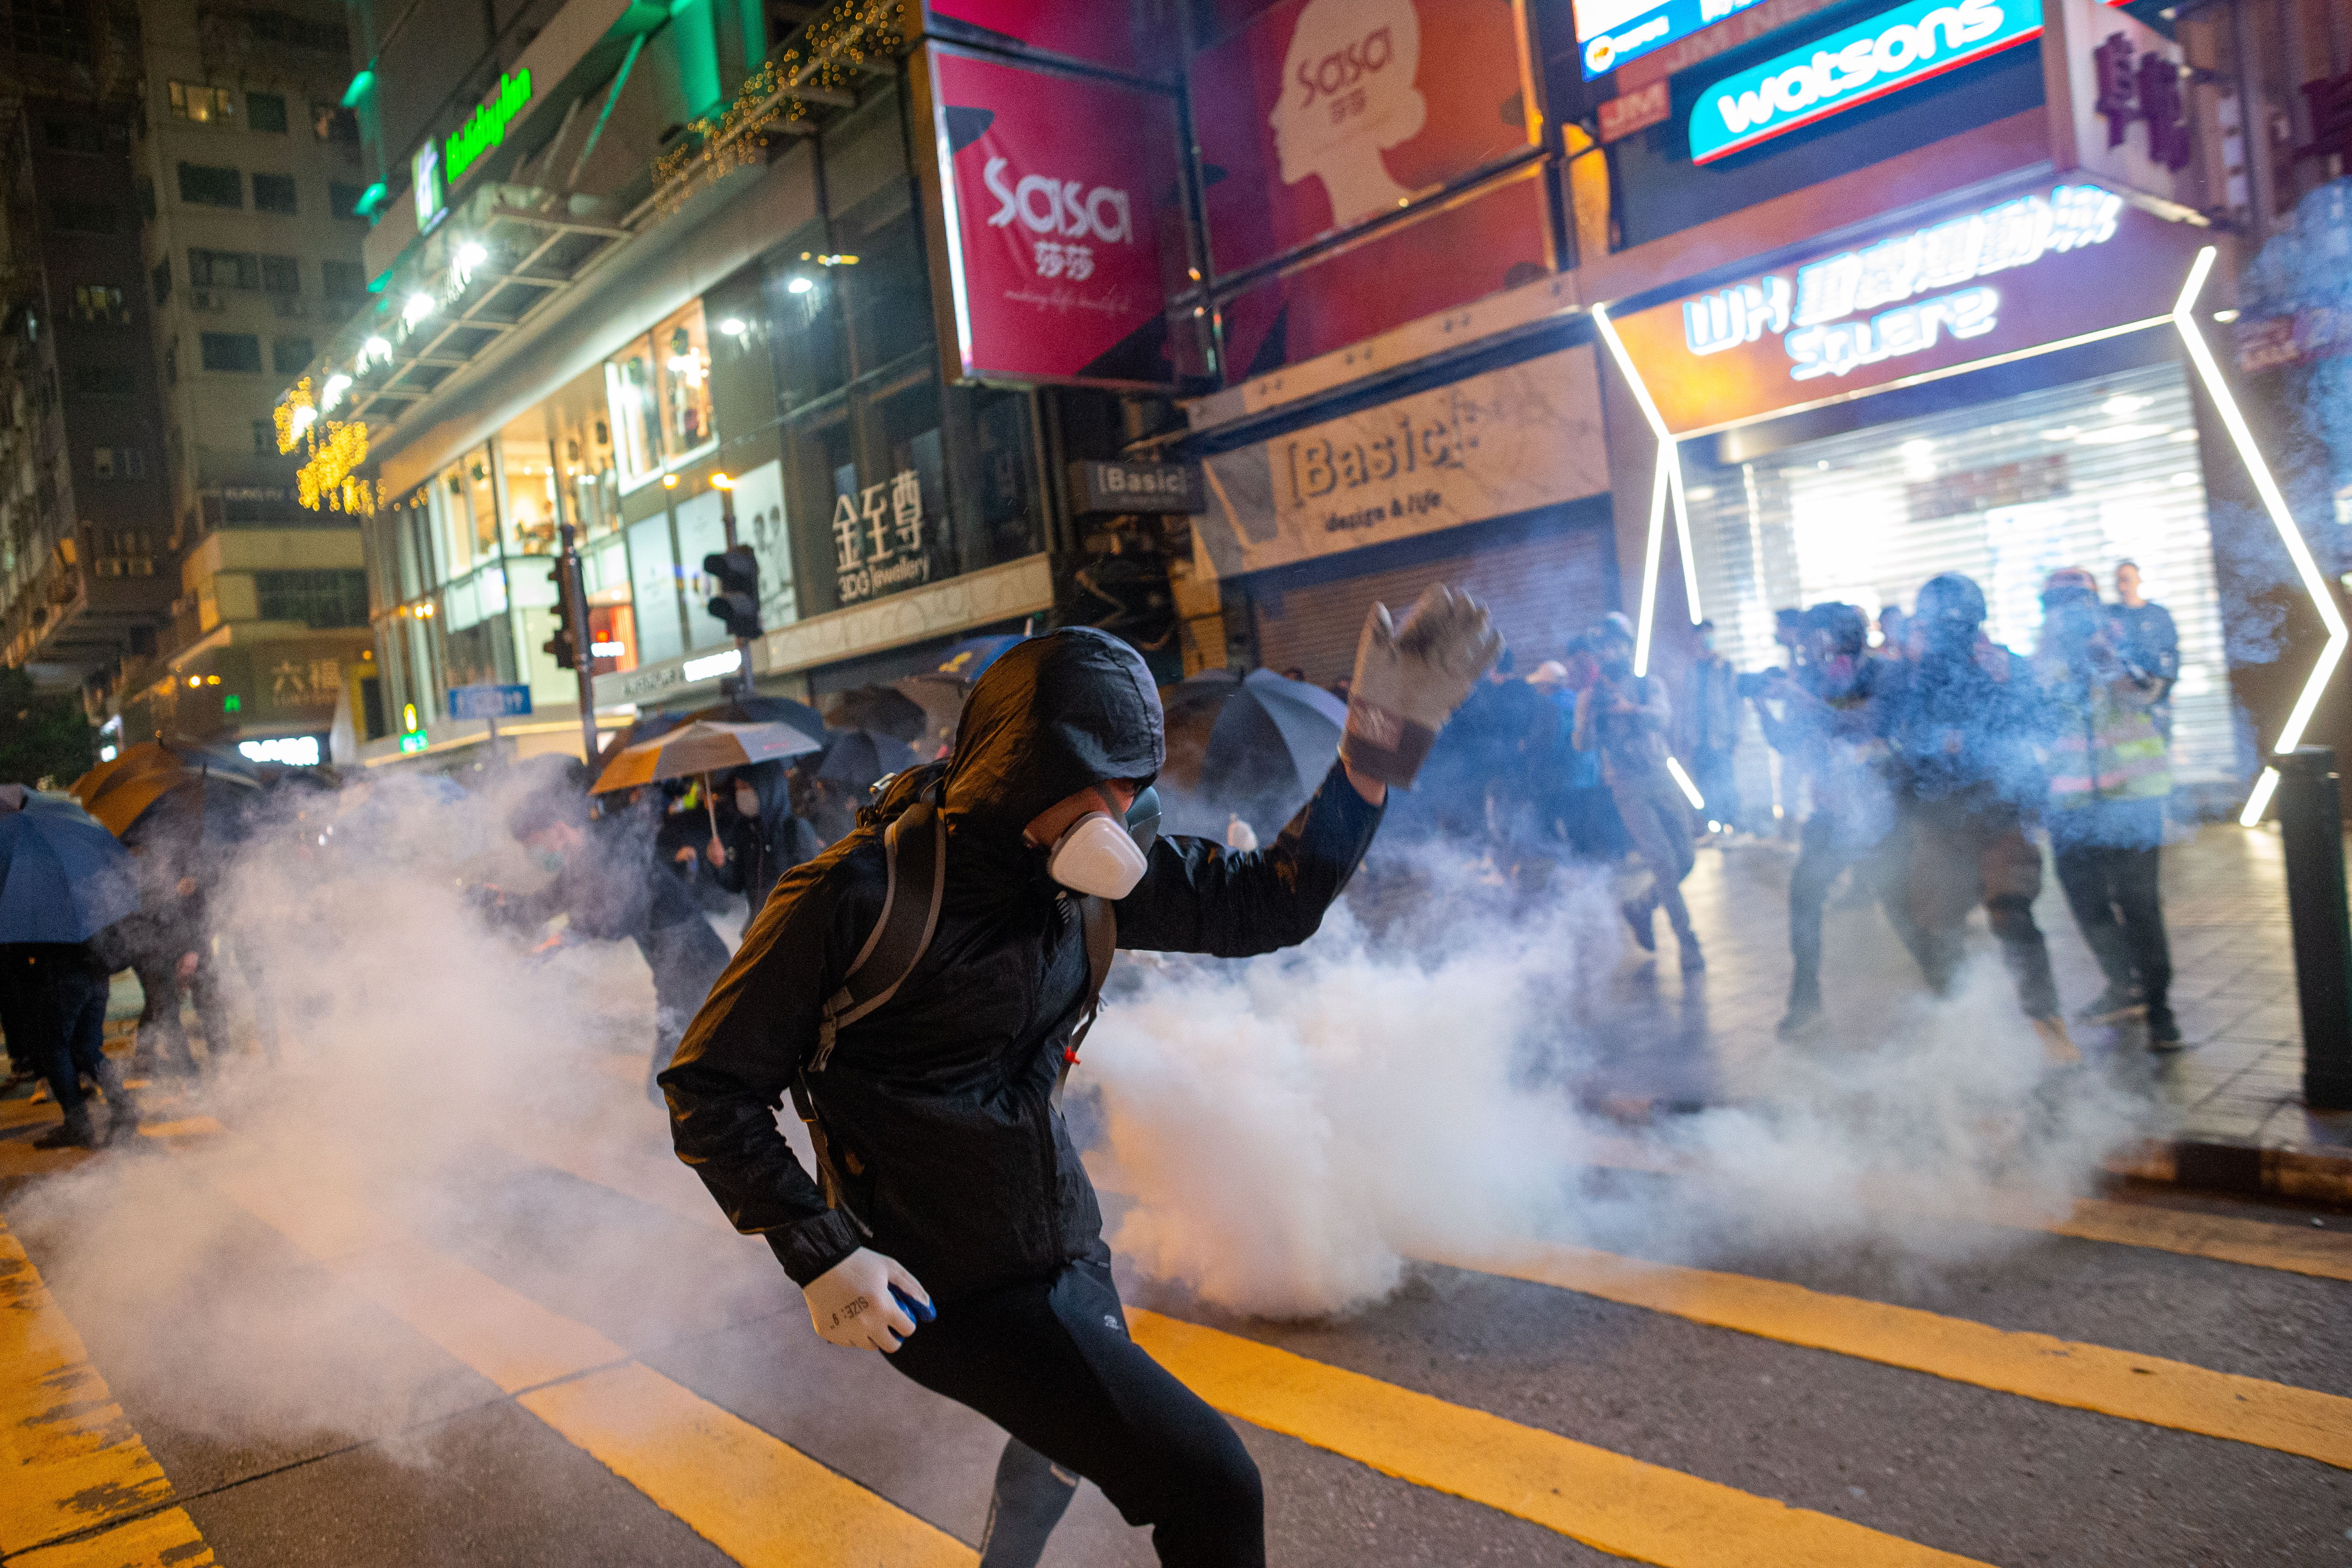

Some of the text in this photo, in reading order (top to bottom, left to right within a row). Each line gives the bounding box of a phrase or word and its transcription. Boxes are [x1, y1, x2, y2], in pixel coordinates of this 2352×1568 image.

[1717, 0, 2004, 133] watsons
[832, 469, 923, 573] 金至尊
